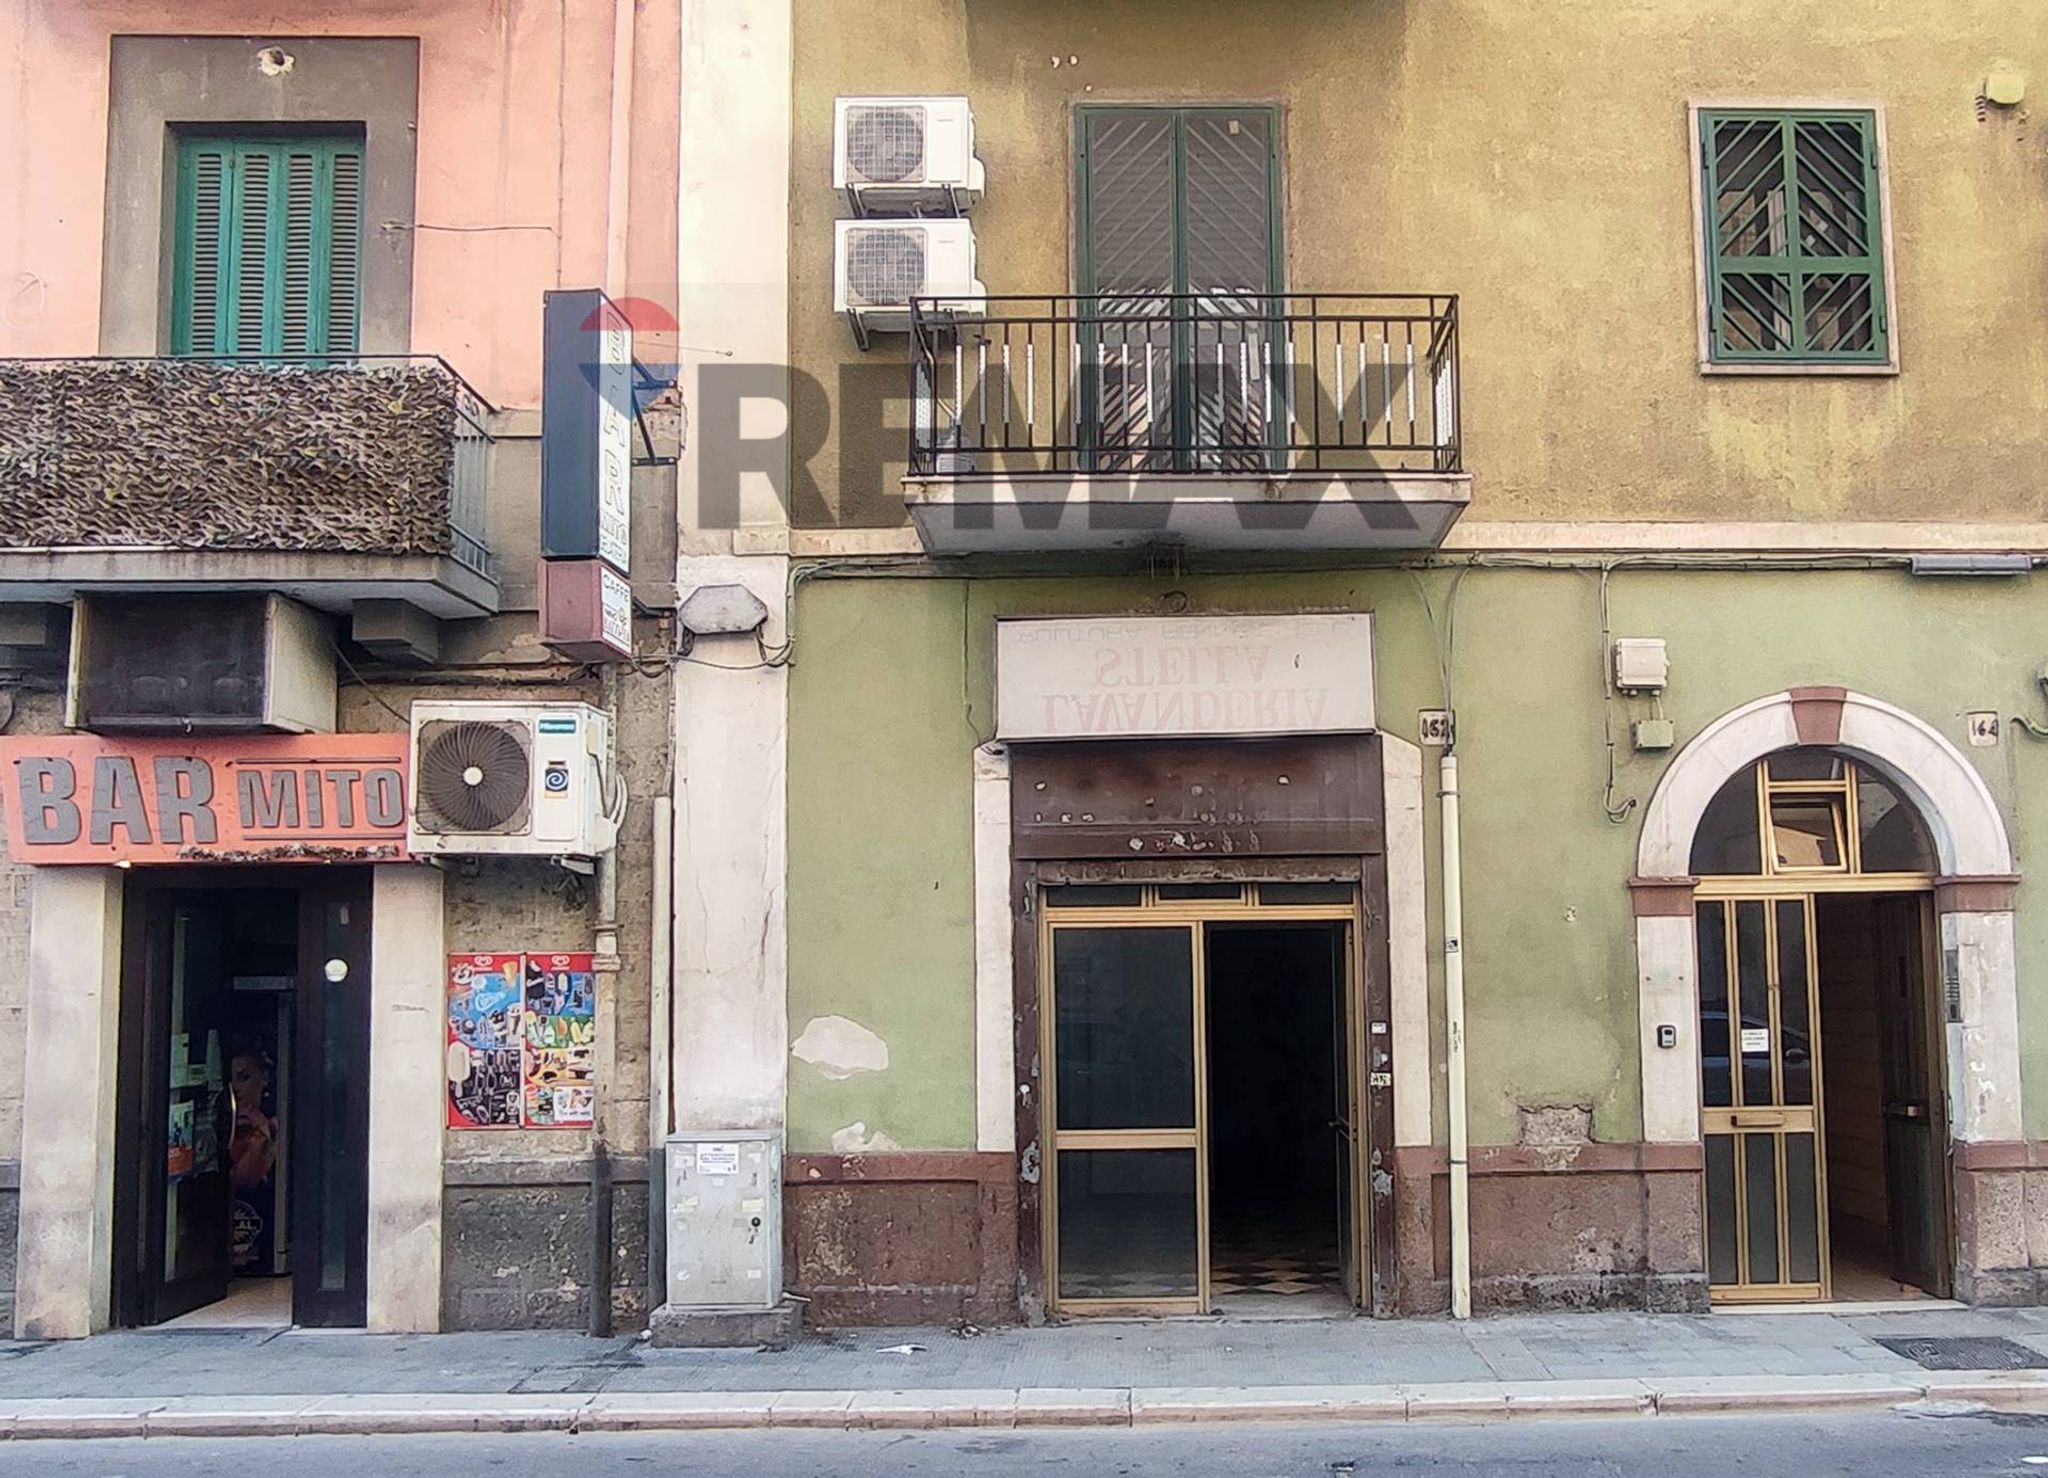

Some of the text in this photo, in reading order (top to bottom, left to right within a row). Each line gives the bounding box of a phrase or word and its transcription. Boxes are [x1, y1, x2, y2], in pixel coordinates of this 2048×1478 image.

[603, 309, 625, 517] BAR
[18, 756, 405, 846] BAR MITO
